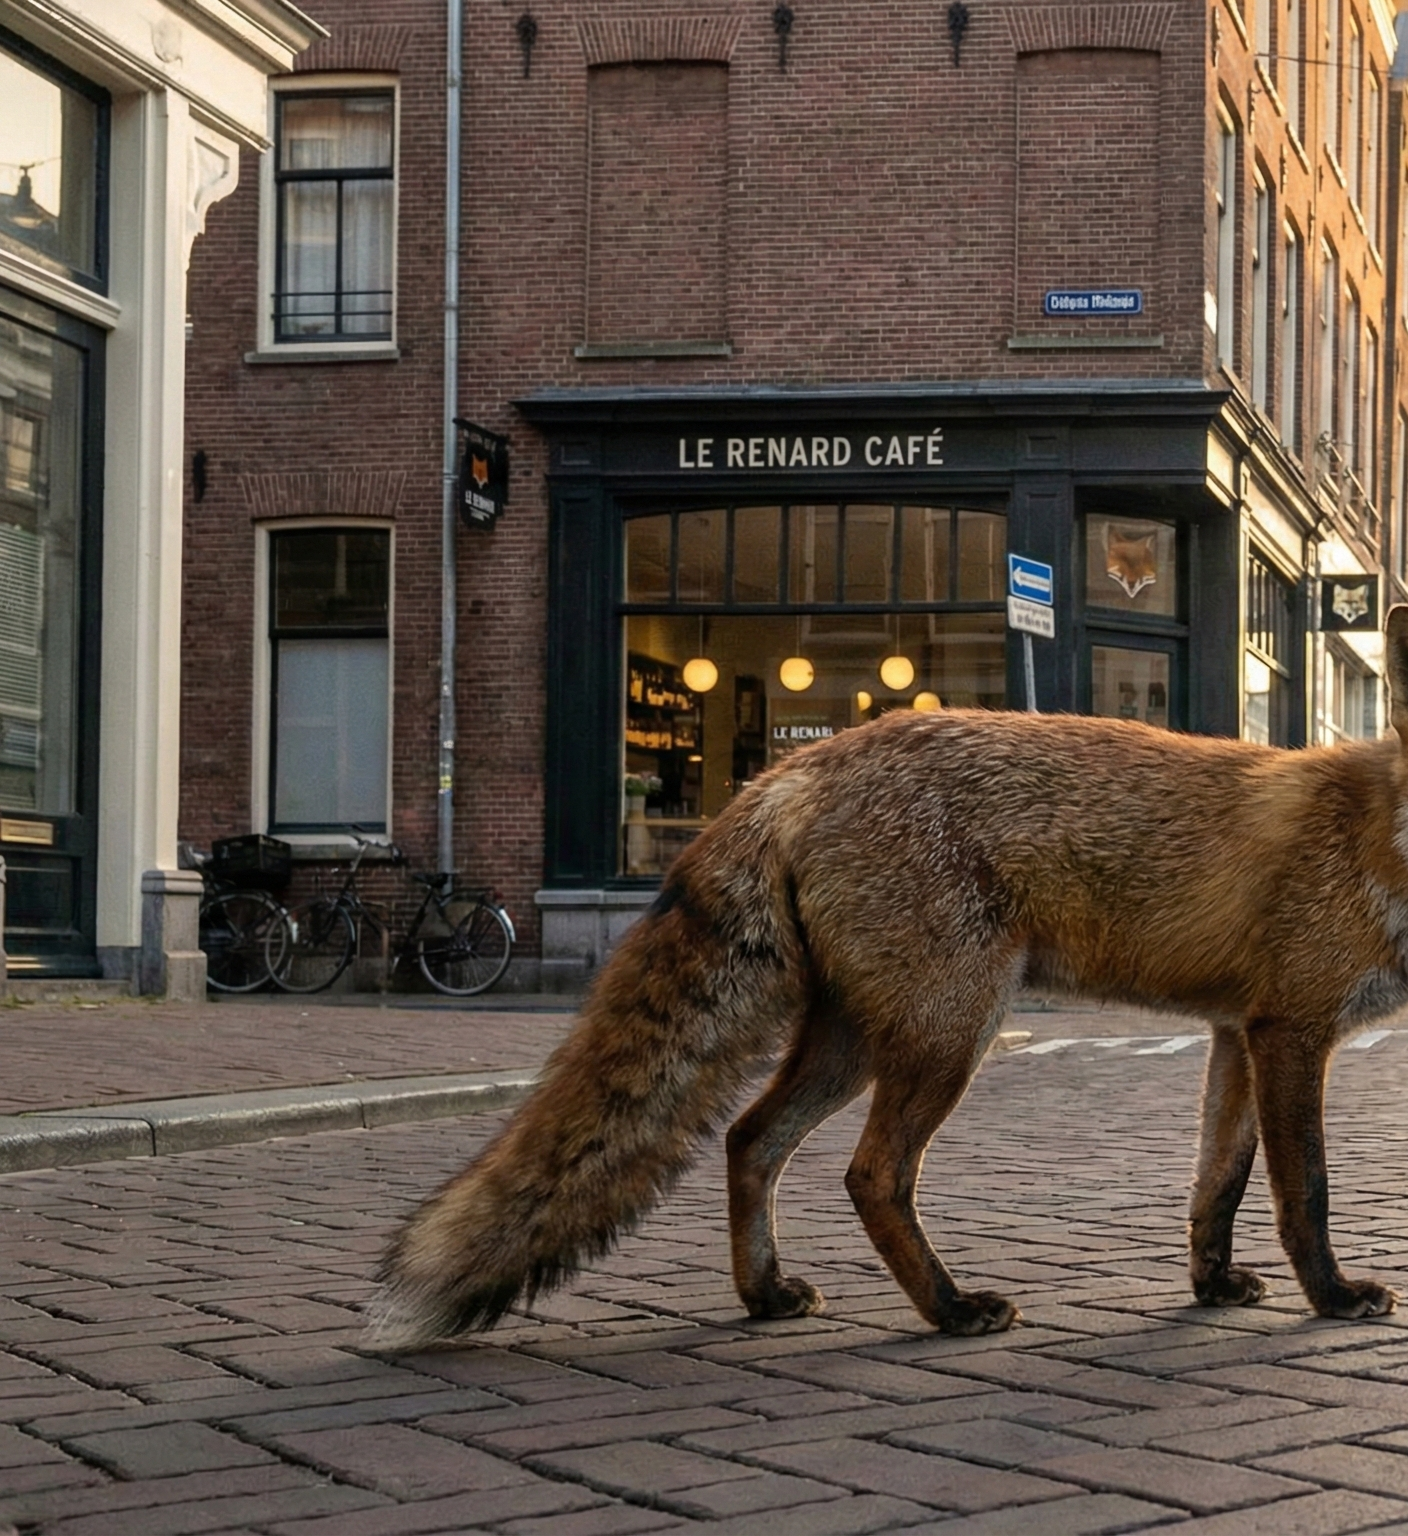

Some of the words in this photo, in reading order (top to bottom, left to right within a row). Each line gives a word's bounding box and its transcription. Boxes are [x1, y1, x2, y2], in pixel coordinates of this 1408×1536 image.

[680, 439, 713, 467] LE
[728, 437, 851, 467] RENARD
[865, 428, 943, 465] CAFÉ
